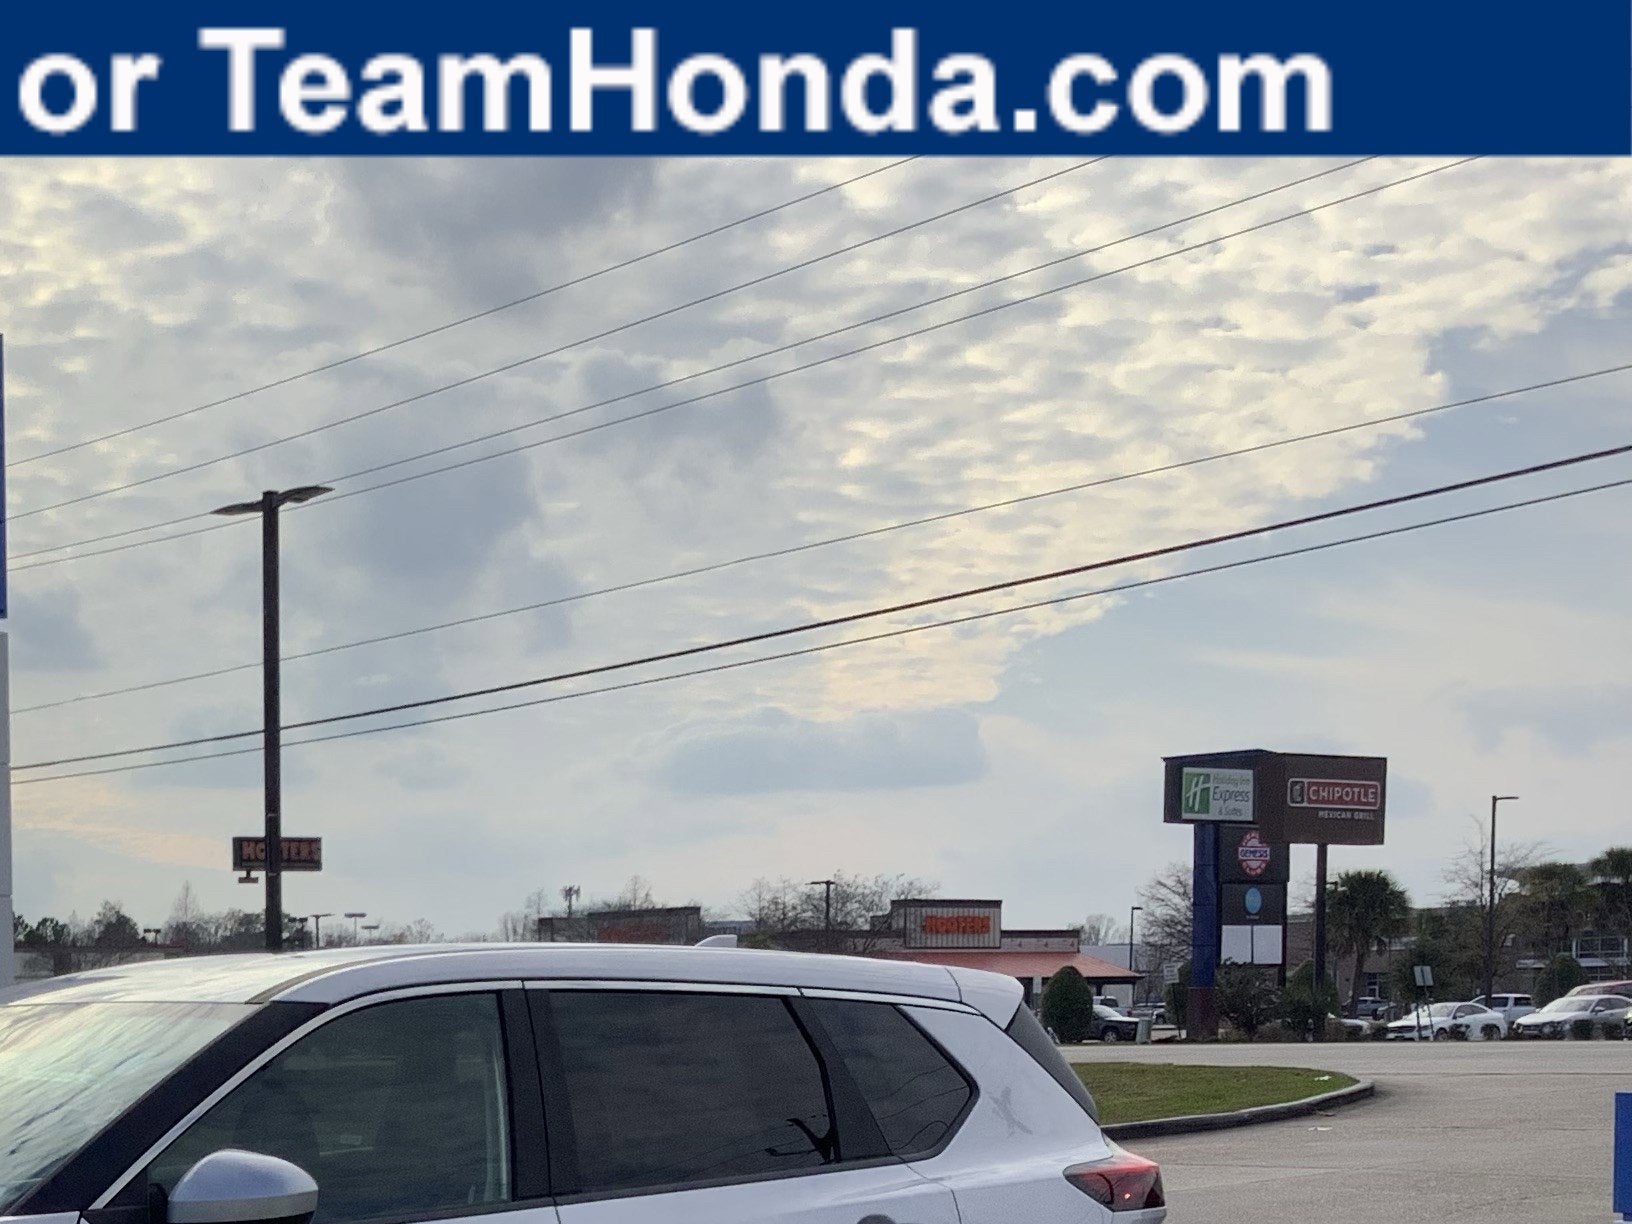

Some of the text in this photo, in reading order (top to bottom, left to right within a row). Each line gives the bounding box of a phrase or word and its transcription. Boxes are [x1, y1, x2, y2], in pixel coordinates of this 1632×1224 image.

[1213, 785, 1250, 803] Express
[1309, 786, 1376, 802] CHIPOTLE
[1318, 811, 1374, 820] MEXICAN GRILL
